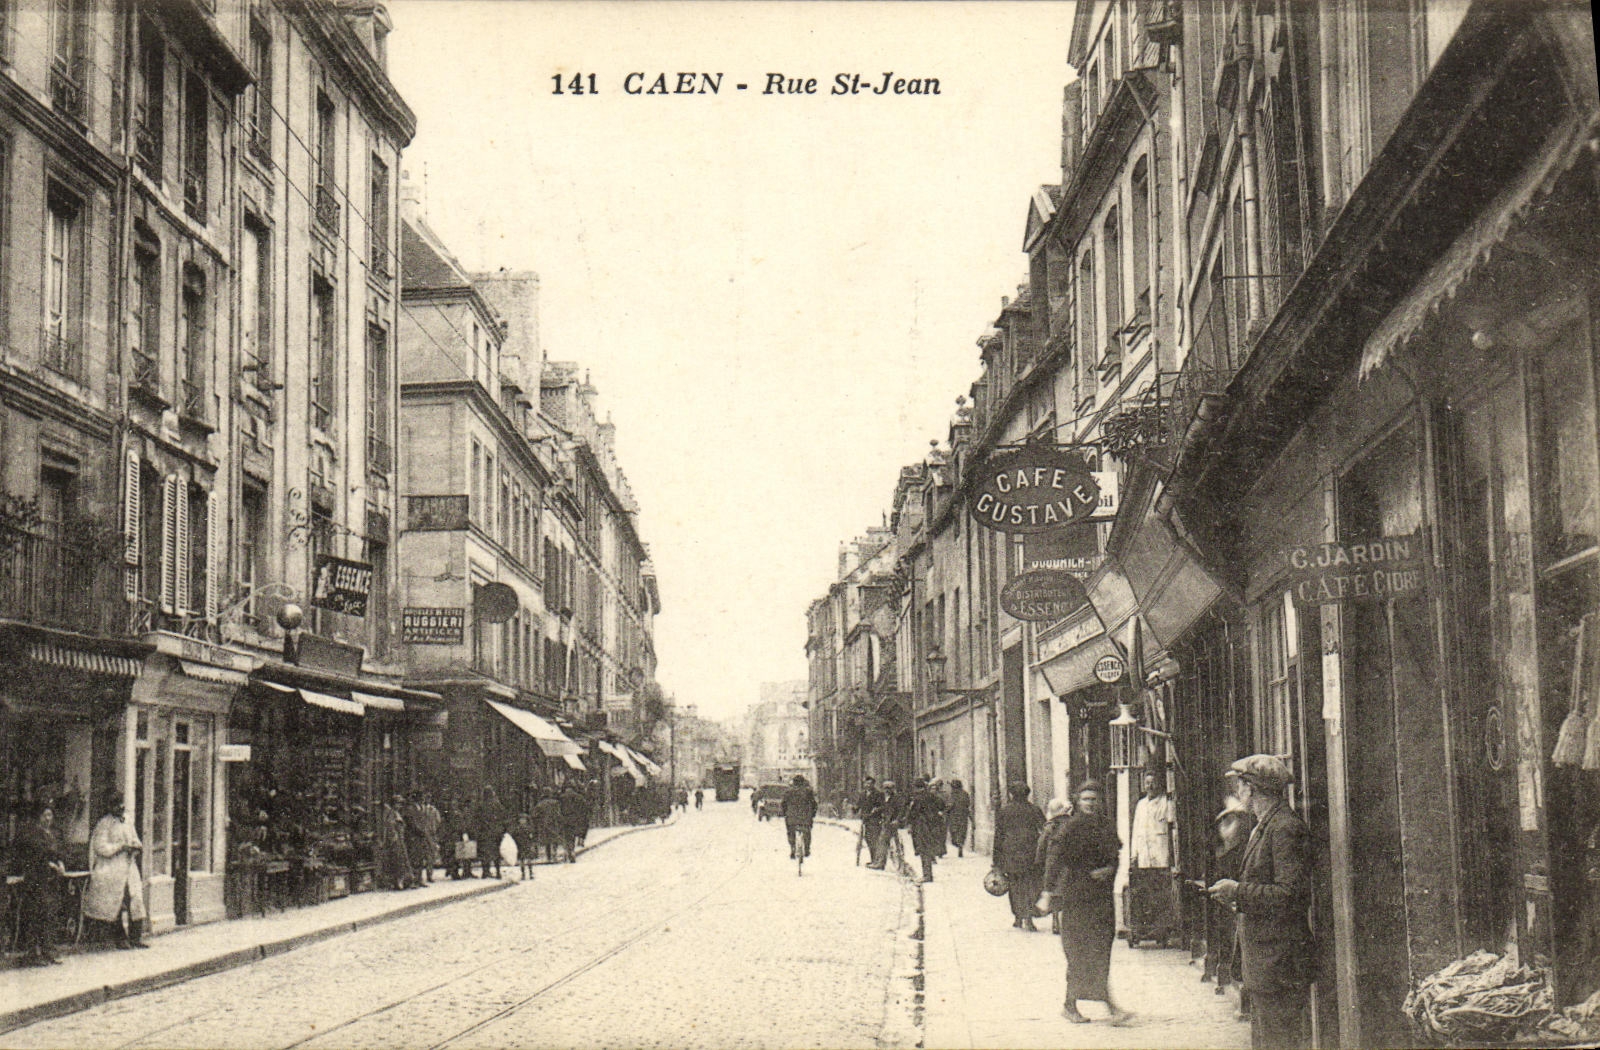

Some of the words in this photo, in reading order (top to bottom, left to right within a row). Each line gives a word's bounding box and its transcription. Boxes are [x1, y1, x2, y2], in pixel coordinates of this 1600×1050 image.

[996, 468, 1065, 493] CAFE
[977, 484, 1093, 525] GUSTAVE
[335, 565, 372, 595] ESSENCE
[404, 615, 463, 628] RUGGIERI
